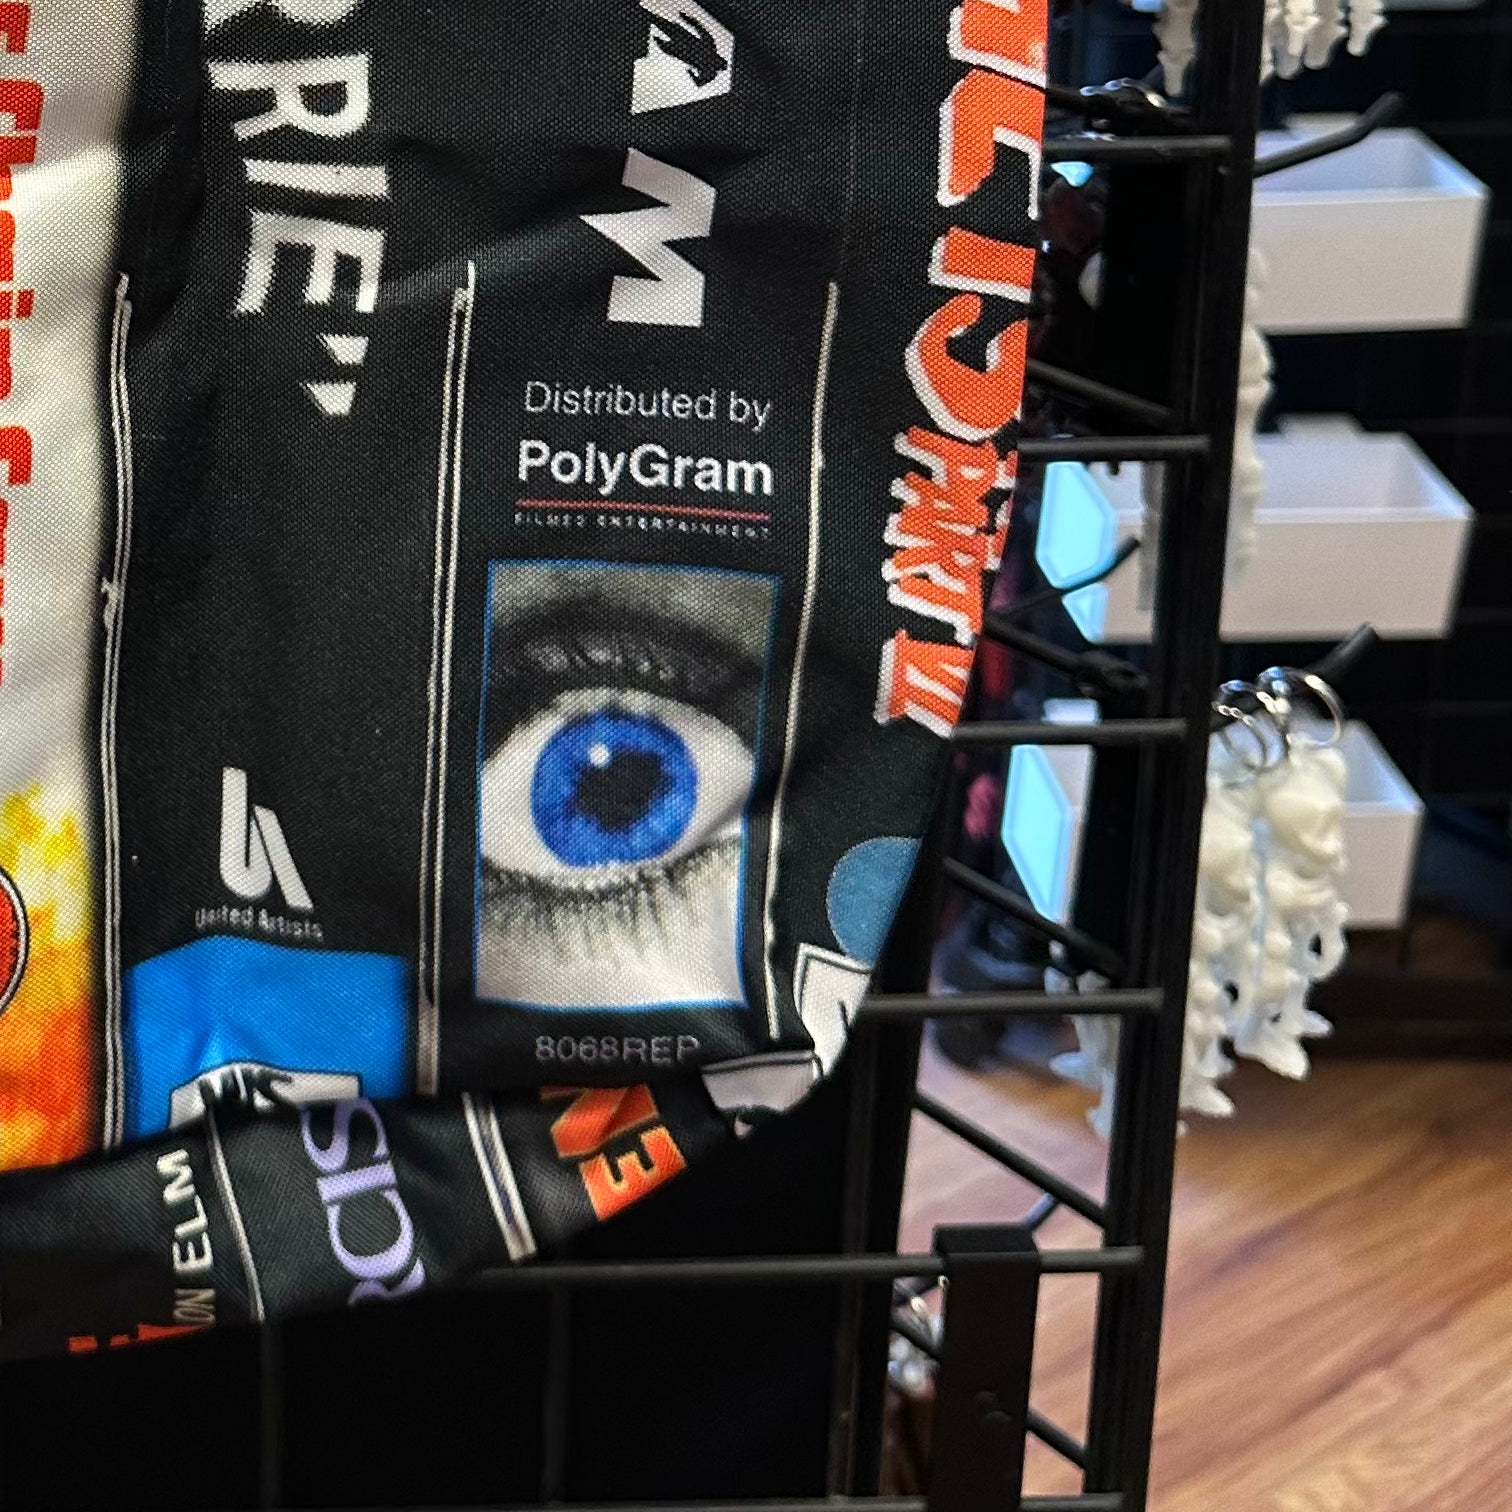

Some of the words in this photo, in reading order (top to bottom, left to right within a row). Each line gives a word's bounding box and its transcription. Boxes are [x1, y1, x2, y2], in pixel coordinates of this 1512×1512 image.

[524, 380, 717, 420] Distributed
[728, 390, 772, 432] by
[518, 438, 774, 496] PolyGram
[882, 426, 1002, 644] PART
[194, 904, 255, 931] United
[535, 1035, 703, 1065] 8068REP
[156, 1148, 213, 1275] ELM
